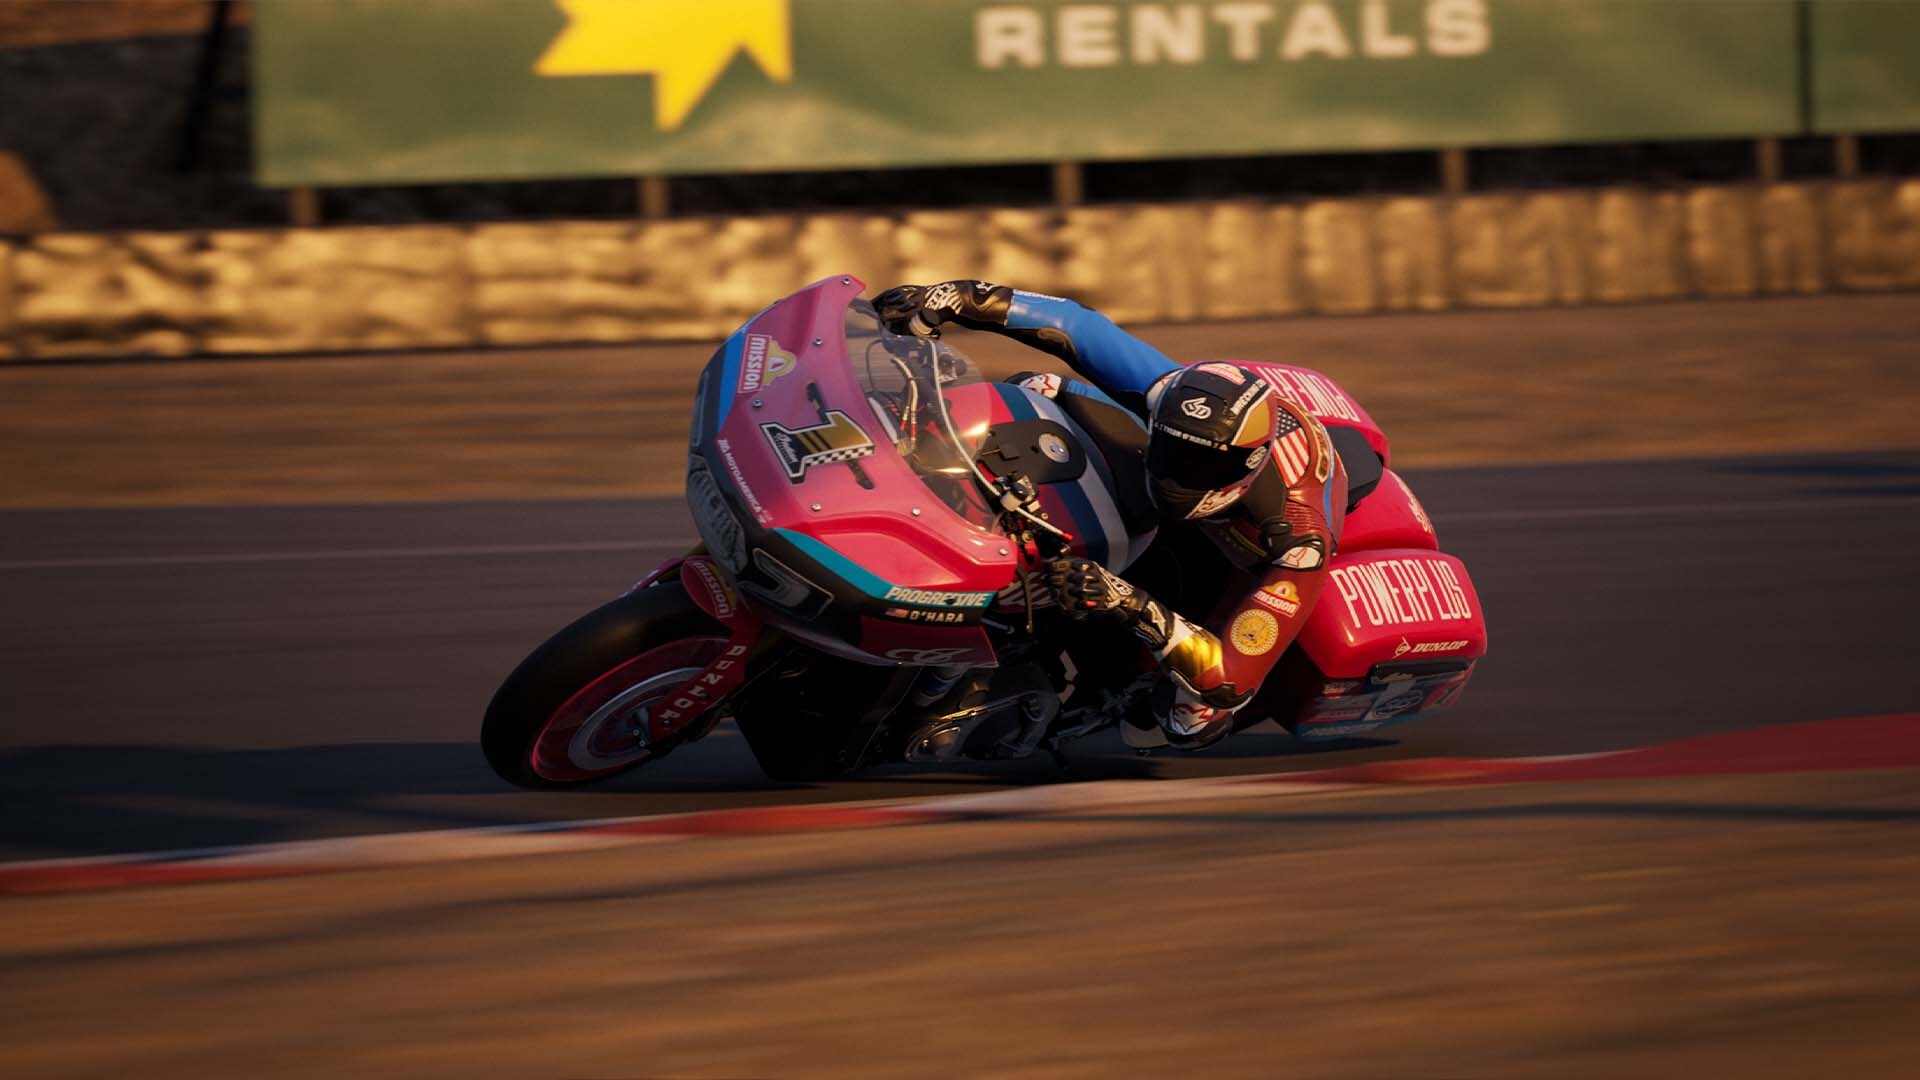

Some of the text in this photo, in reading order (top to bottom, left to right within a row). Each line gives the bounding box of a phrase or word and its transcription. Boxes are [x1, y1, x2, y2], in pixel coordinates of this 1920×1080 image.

[975, 0, 1494, 69] RENTALS
[909, 610, 965, 622] O'HARA
[1329, 559, 1472, 629] POWERPLUS
[1411, 640, 1469, 653] DUNLOP
[659, 645, 747, 719] DUNLOP
